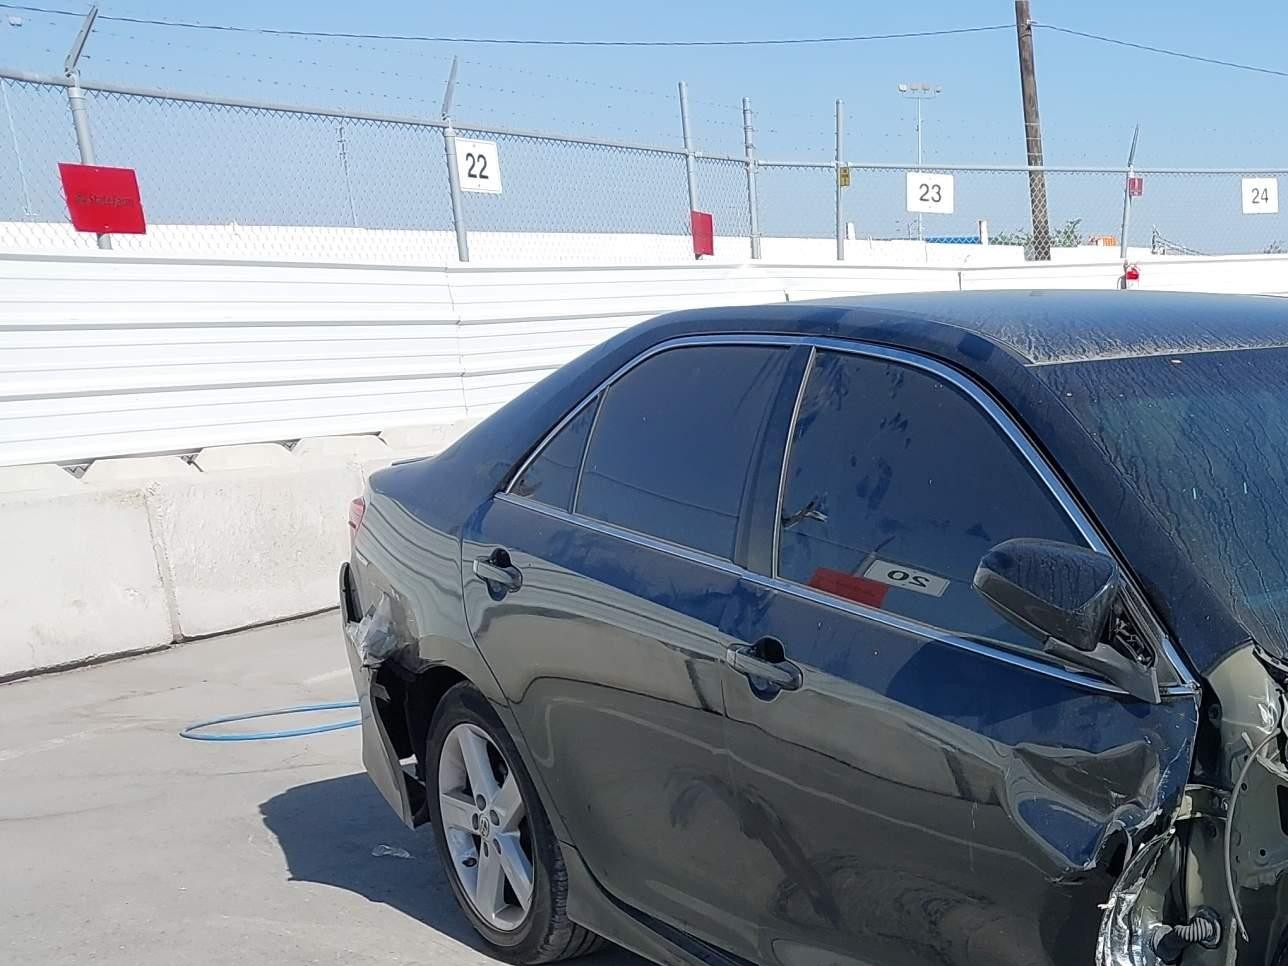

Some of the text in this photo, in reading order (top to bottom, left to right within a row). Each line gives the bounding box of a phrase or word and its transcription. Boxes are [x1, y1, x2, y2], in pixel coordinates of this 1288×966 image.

[465, 152, 489, 179] 22
[919, 183, 942, 203] 23
[1251, 187, 1269, 204] 24
